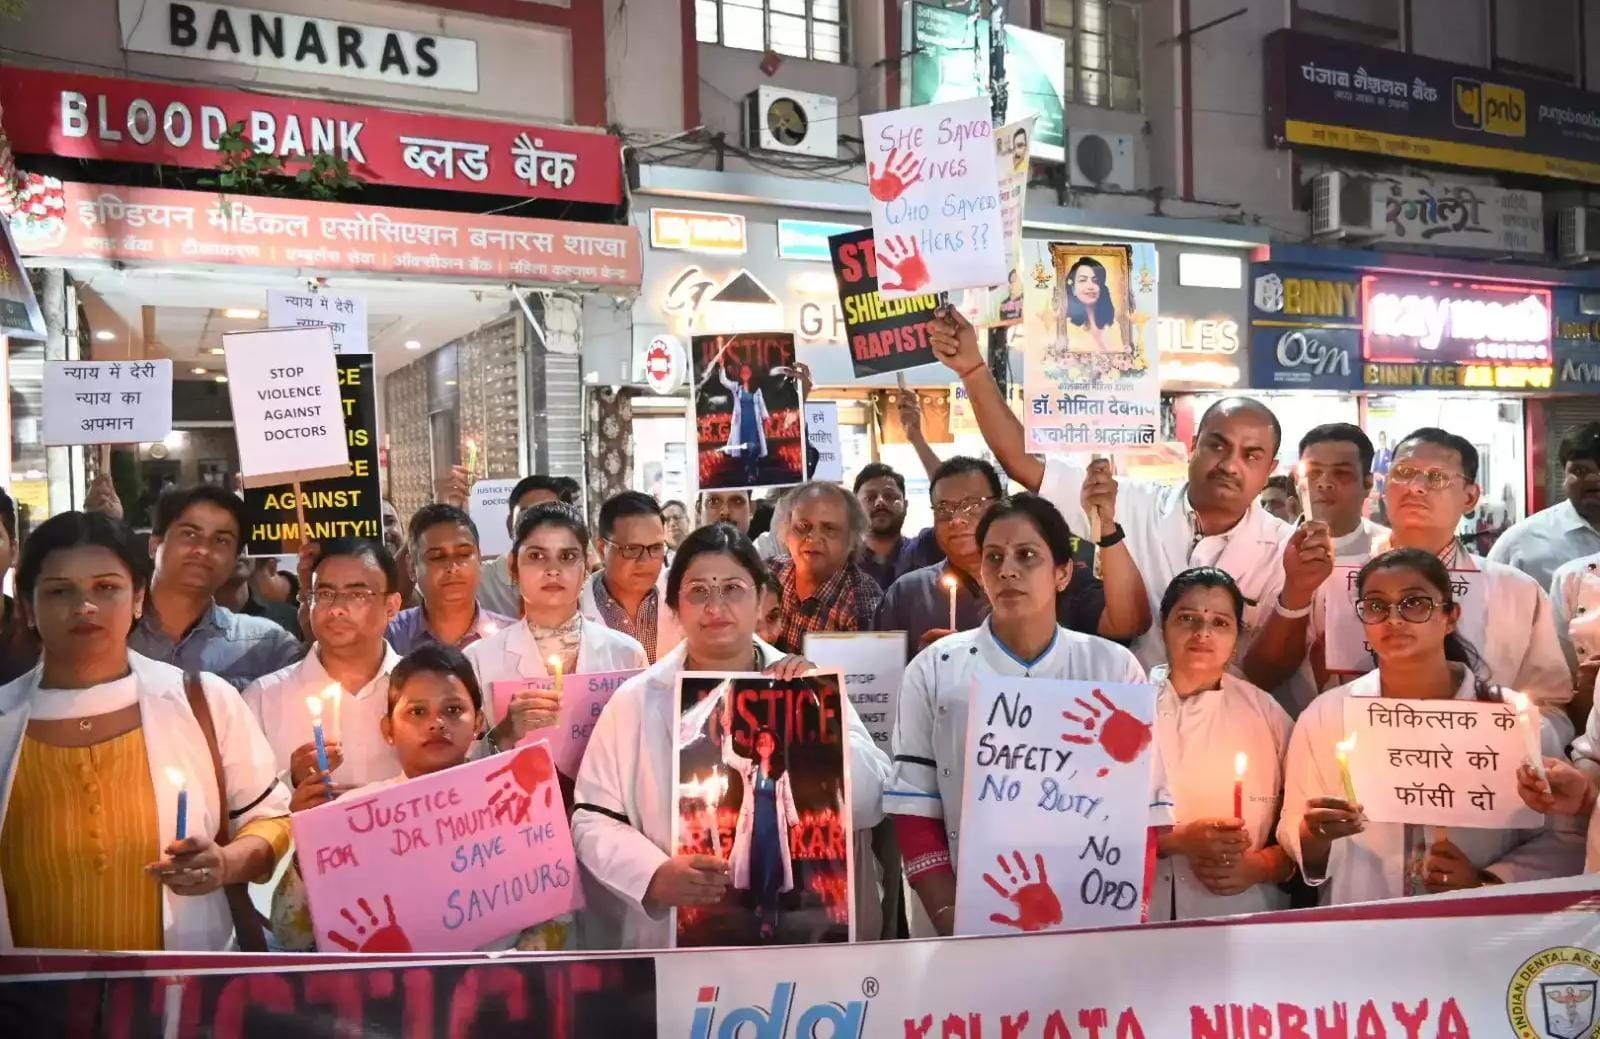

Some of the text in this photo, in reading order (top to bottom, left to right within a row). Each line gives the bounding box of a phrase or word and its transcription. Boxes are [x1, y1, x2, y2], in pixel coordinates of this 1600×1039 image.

[169, 4, 439, 78] BANARAS
[1486, 93, 1521, 125] pnb
[61, 90, 366, 164] BLOOD BANK
[880, 124, 924, 152] SHE
[938, 117, 992, 152] SAVED
[401, 133, 577, 189] ब्लड बैंक
[320, 211, 459, 247] एसोसिएशन
[468, 227, 554, 254] बनारस
[562, 234, 628, 259] शाखा
[845, 293, 937, 325] SHIELDING
[1284, 278, 1360, 316] BINNY
[853, 324, 929, 361] RAPIST
[1157, 320, 1237, 352] ILES
[64, 362, 155, 380] न्याय में देरी
[270, 367, 304, 379] STOP
[1364, 365, 1426, 385] BINNY
[75, 391, 141, 406] न्याय का
[258, 386, 322, 400] VIOLENCE
[1057, 393, 1104, 415] मौमिता
[80, 418, 133, 431] अपमान
[264, 406, 321, 420] AGAINST
[264, 426, 327, 441] DOCTORS
[264, 491, 361, 510] AGAINST
[252, 520, 378, 540] HUMANITY!!
[1367, 703, 1516, 731] चिकित्सक के
[1387, 743, 1499, 771] हत्यारे को
[345, 787, 460, 834] JUSTICE
[1467, 784, 1496, 810] दो
[316, 844, 360, 873] FOR
[390, 828, 431, 856] DR
[451, 822, 555, 873] SAVE THE
[442, 858, 571, 930] SAVIOURS
[1080, 868, 1138, 911] OPD
[1512, 982, 1527, 1030] INDIAN
[1520, 952, 1568, 981] DENTAL
